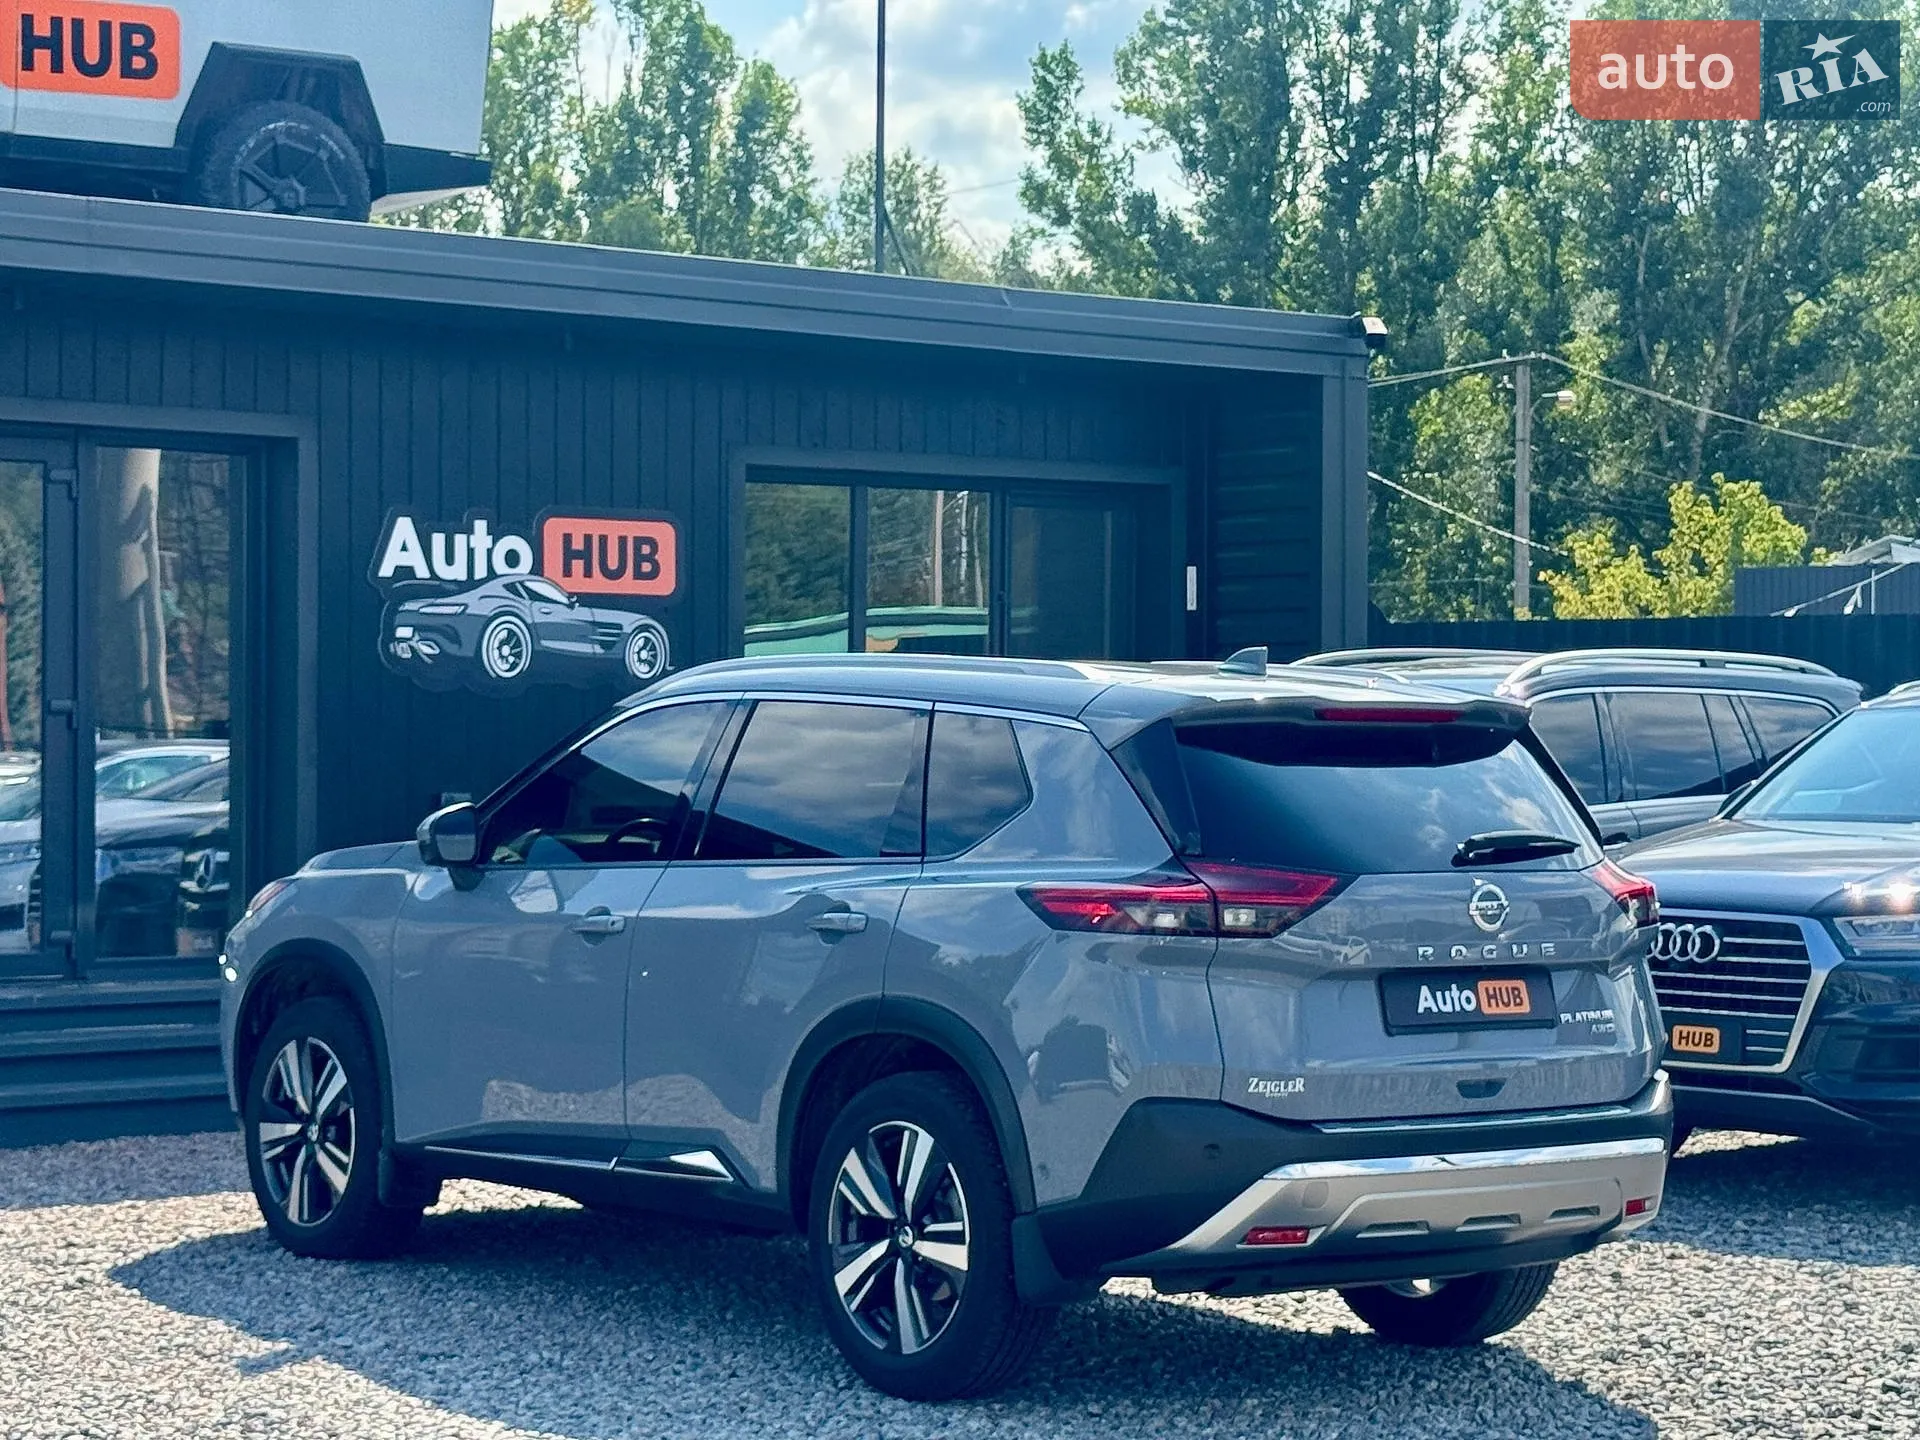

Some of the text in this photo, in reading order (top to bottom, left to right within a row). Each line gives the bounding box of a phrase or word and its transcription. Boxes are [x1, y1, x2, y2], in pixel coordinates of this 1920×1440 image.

[21, 13, 159, 80] HUB
[378, 516, 661, 580] Auto HUB
[1418, 943, 1556, 961] ROGUE
[1417, 984, 1524, 1013] Auto HUB
[1677, 1030, 1714, 1047] HUB
[1248, 1077, 1305, 1097] ZEIGLER
